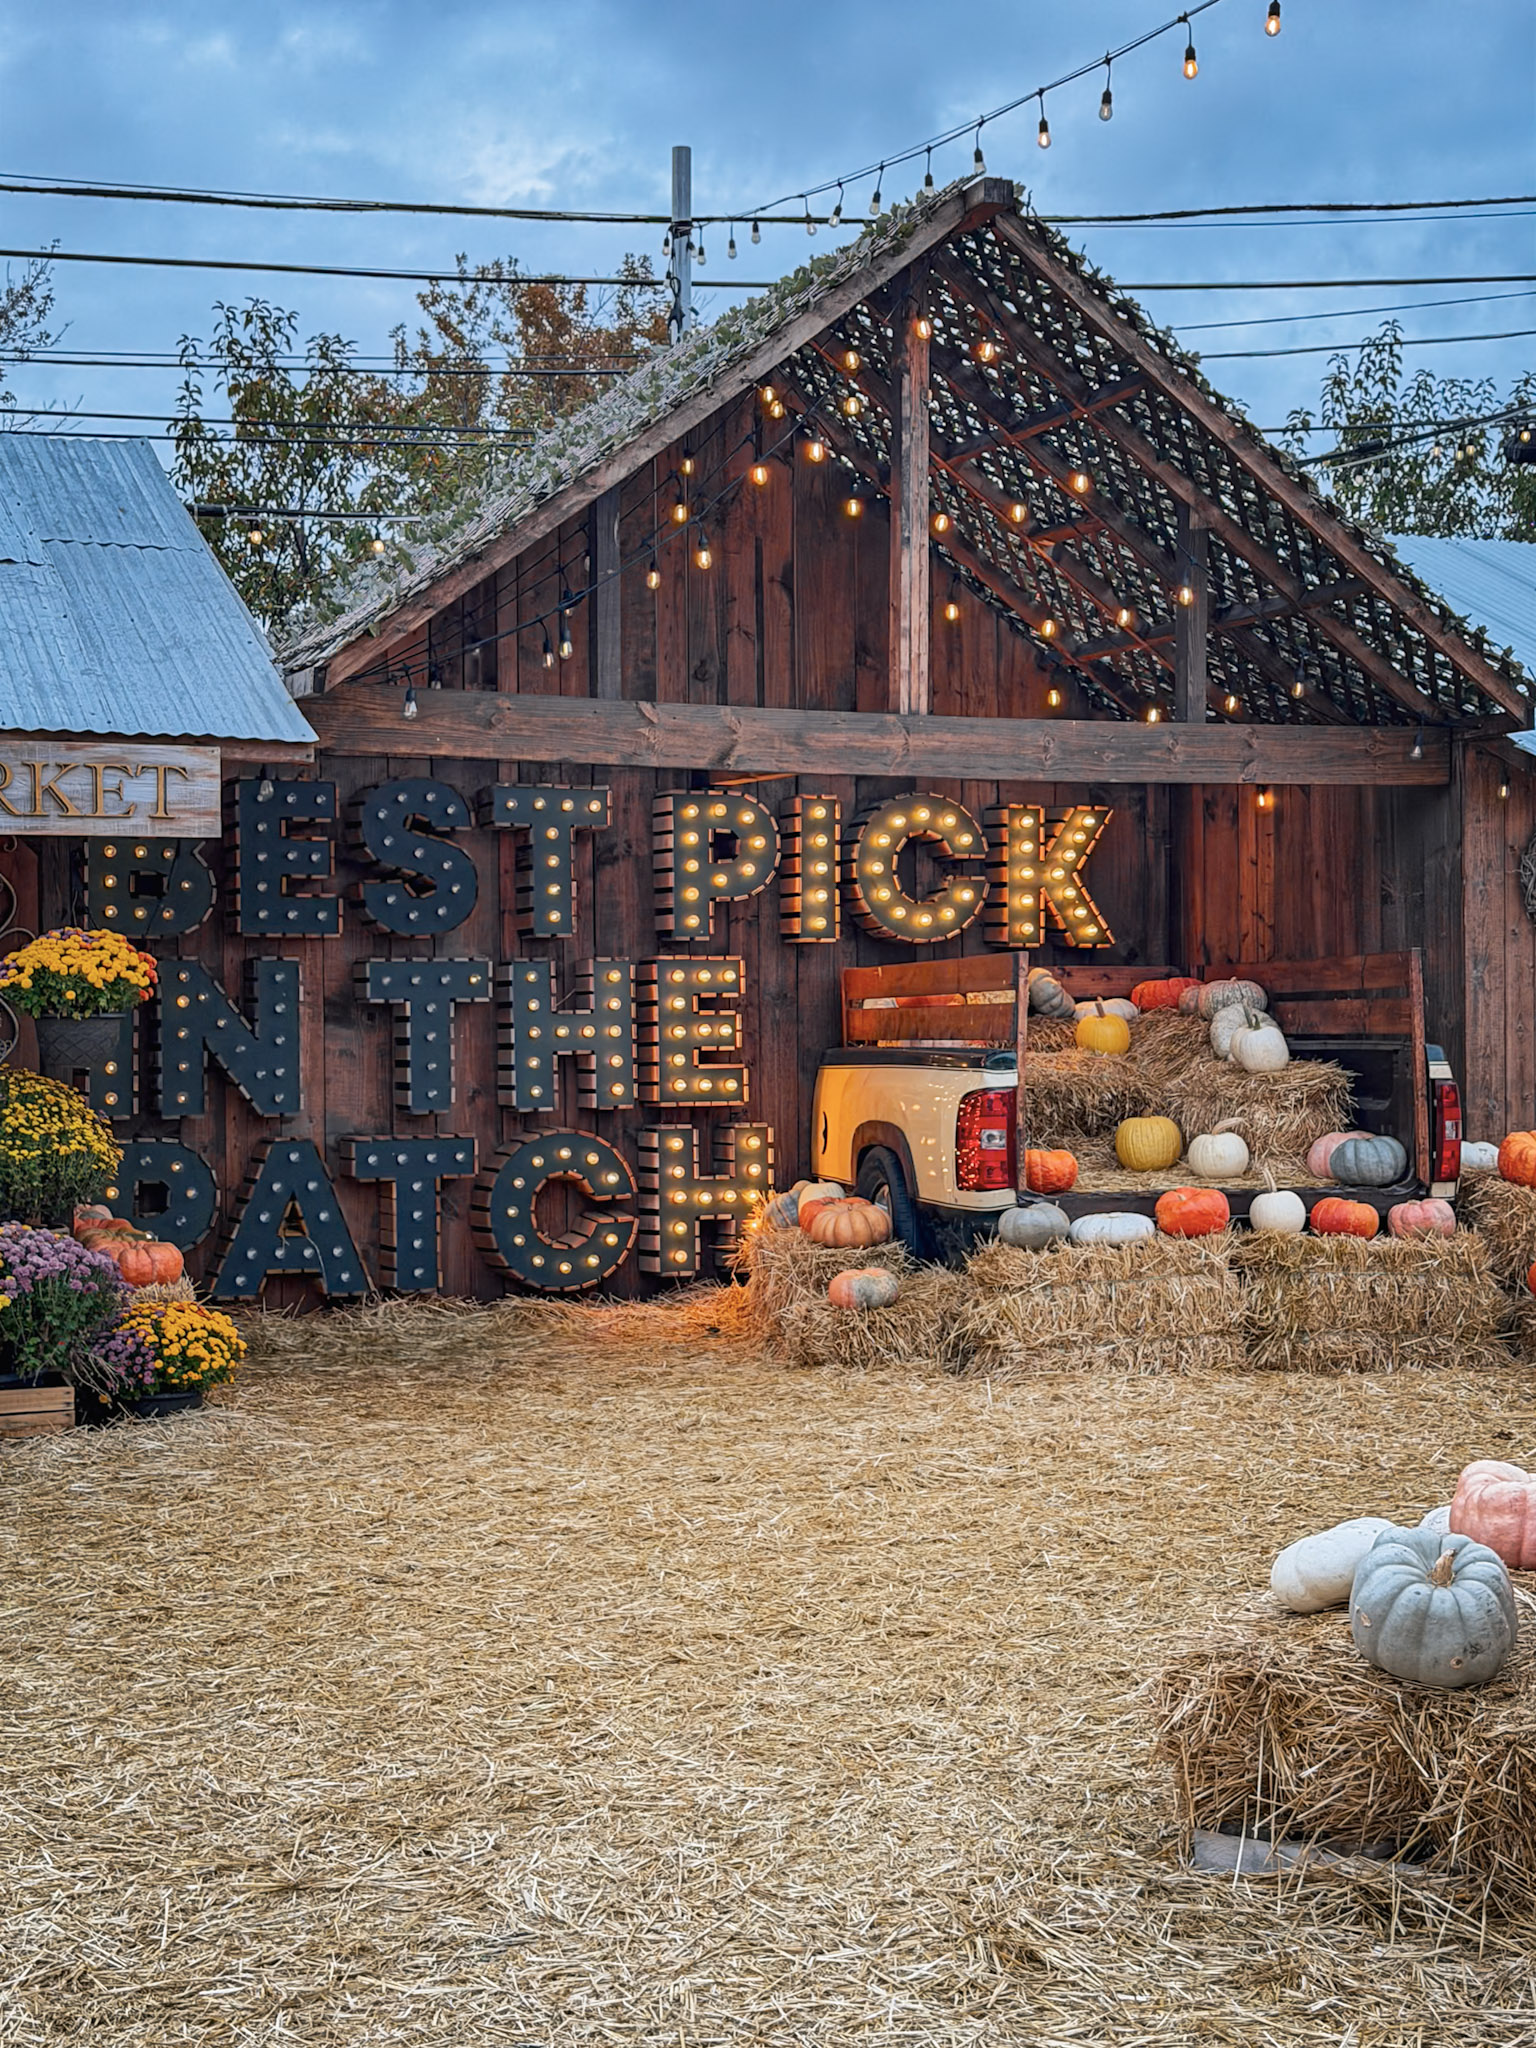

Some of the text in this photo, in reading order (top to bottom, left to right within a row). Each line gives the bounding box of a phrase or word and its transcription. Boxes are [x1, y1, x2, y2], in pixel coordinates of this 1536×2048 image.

[83, 775, 1116, 948] BEST PICK
[355, 955, 750, 1115] THE
[92, 1122, 775, 1298] PATCH
